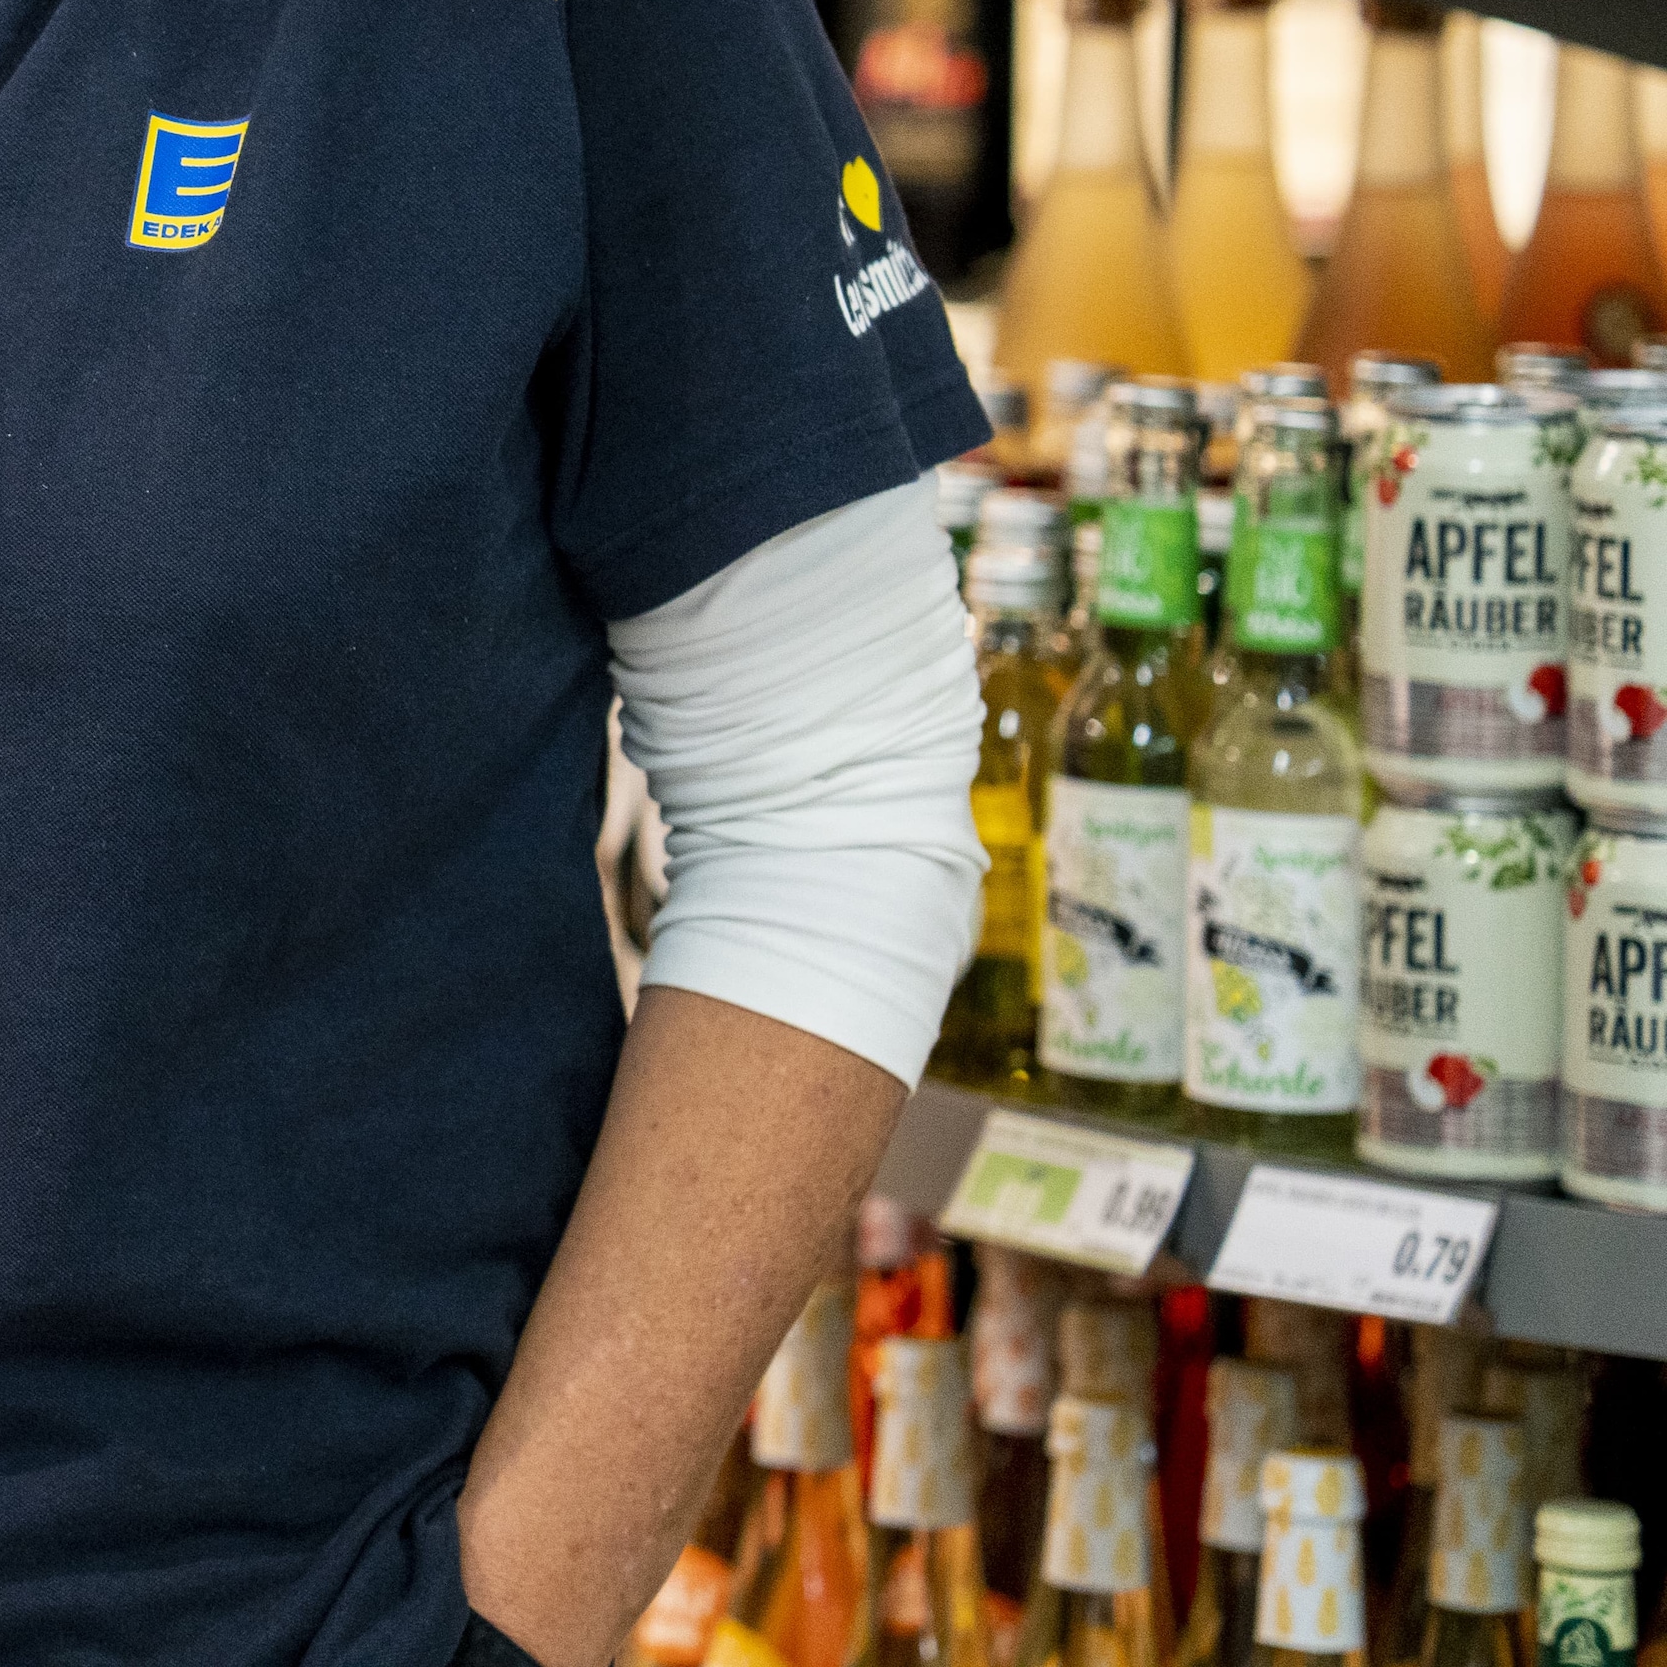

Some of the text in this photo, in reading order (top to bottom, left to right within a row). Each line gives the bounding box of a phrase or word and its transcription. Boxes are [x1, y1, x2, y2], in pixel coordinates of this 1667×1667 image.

[143, 215, 221, 239] EDEKA
[1405, 516, 1558, 586] APFEL
[1571, 531, 1646, 606] FEL
[1589, 932, 1667, 1004] APF
[1392, 1231, 1470, 1284] 0.79
